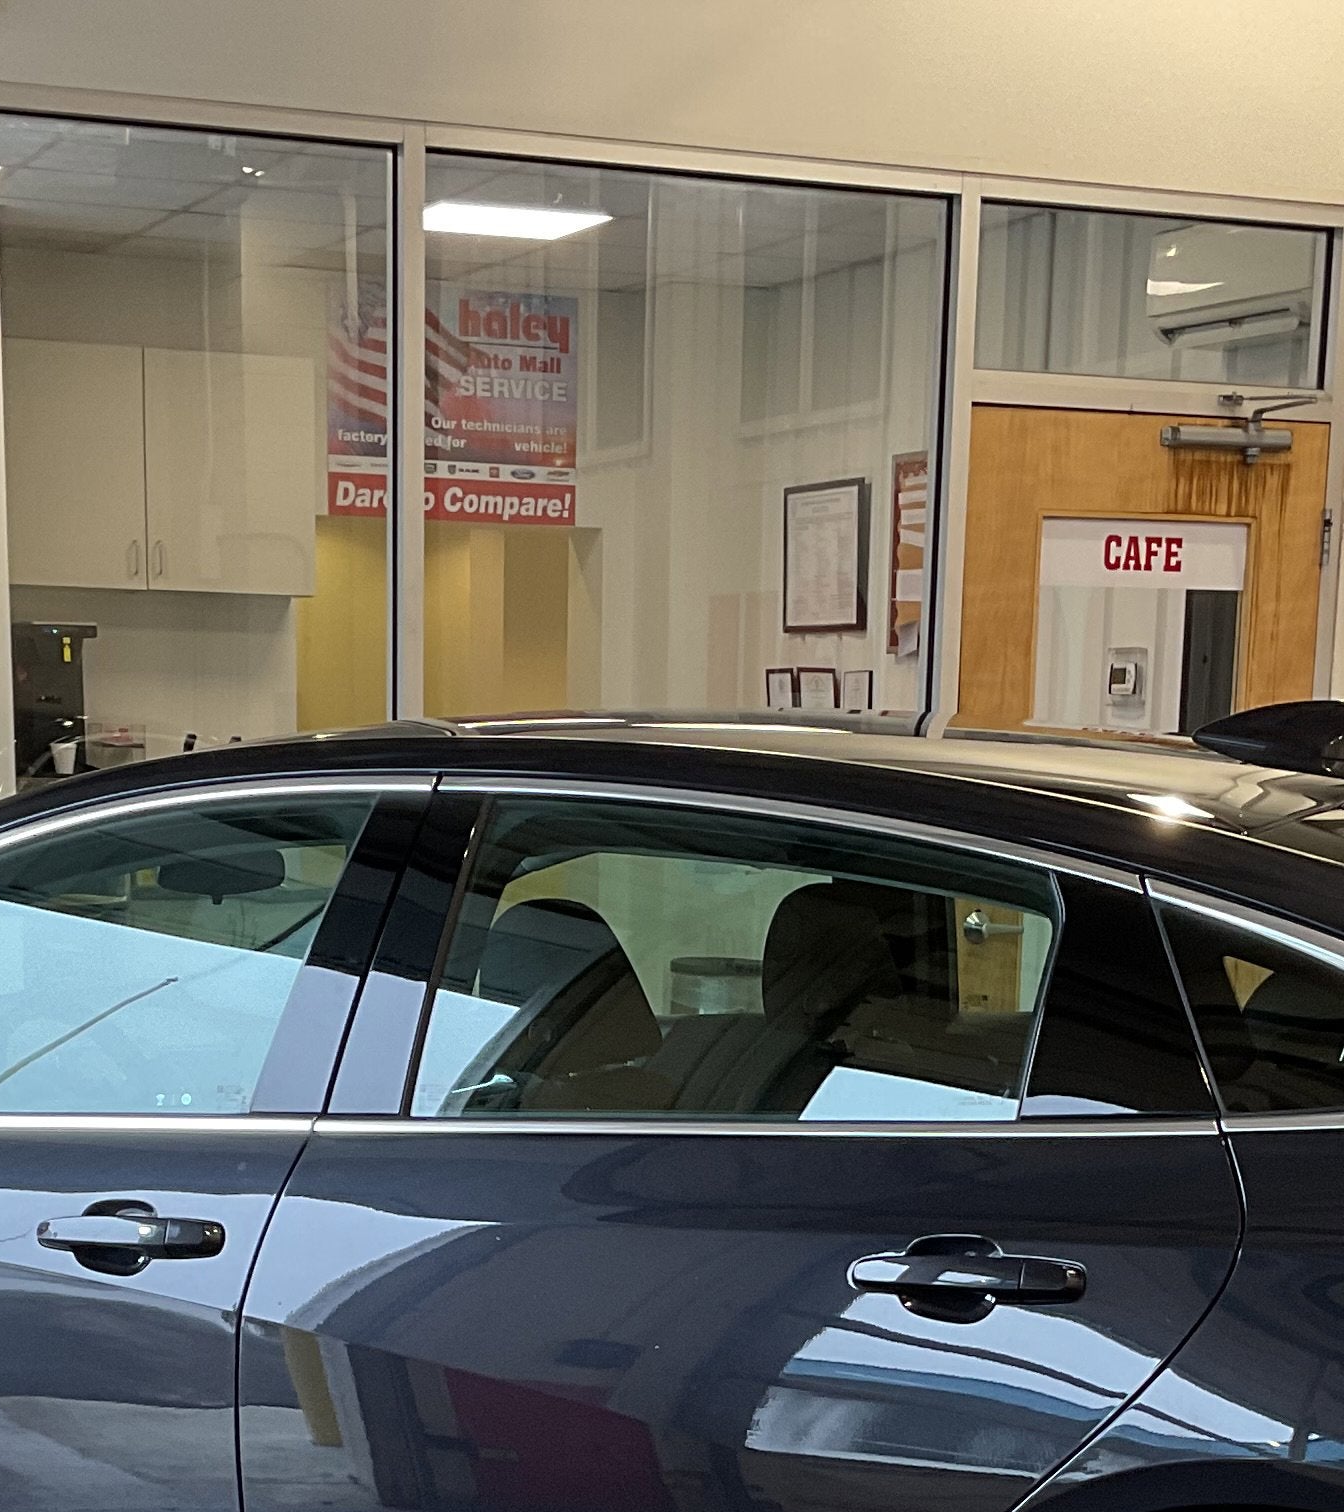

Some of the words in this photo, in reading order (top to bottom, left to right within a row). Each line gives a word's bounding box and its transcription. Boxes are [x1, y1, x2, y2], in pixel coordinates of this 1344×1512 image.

[459, 298, 570, 353] haley
[467, 352, 512, 372] Auto
[518, 354, 561, 374] Mall
[458, 375, 567, 402] SERVICE
[431, 416, 456, 430] Our
[461, 418, 541, 436] technicians
[545, 425, 567, 436] are
[447, 436, 467, 450] for
[514, 440, 567, 454] vehicle!
[443, 486, 572, 521] Compare!
[1104, 534, 1184, 572] CAFE
